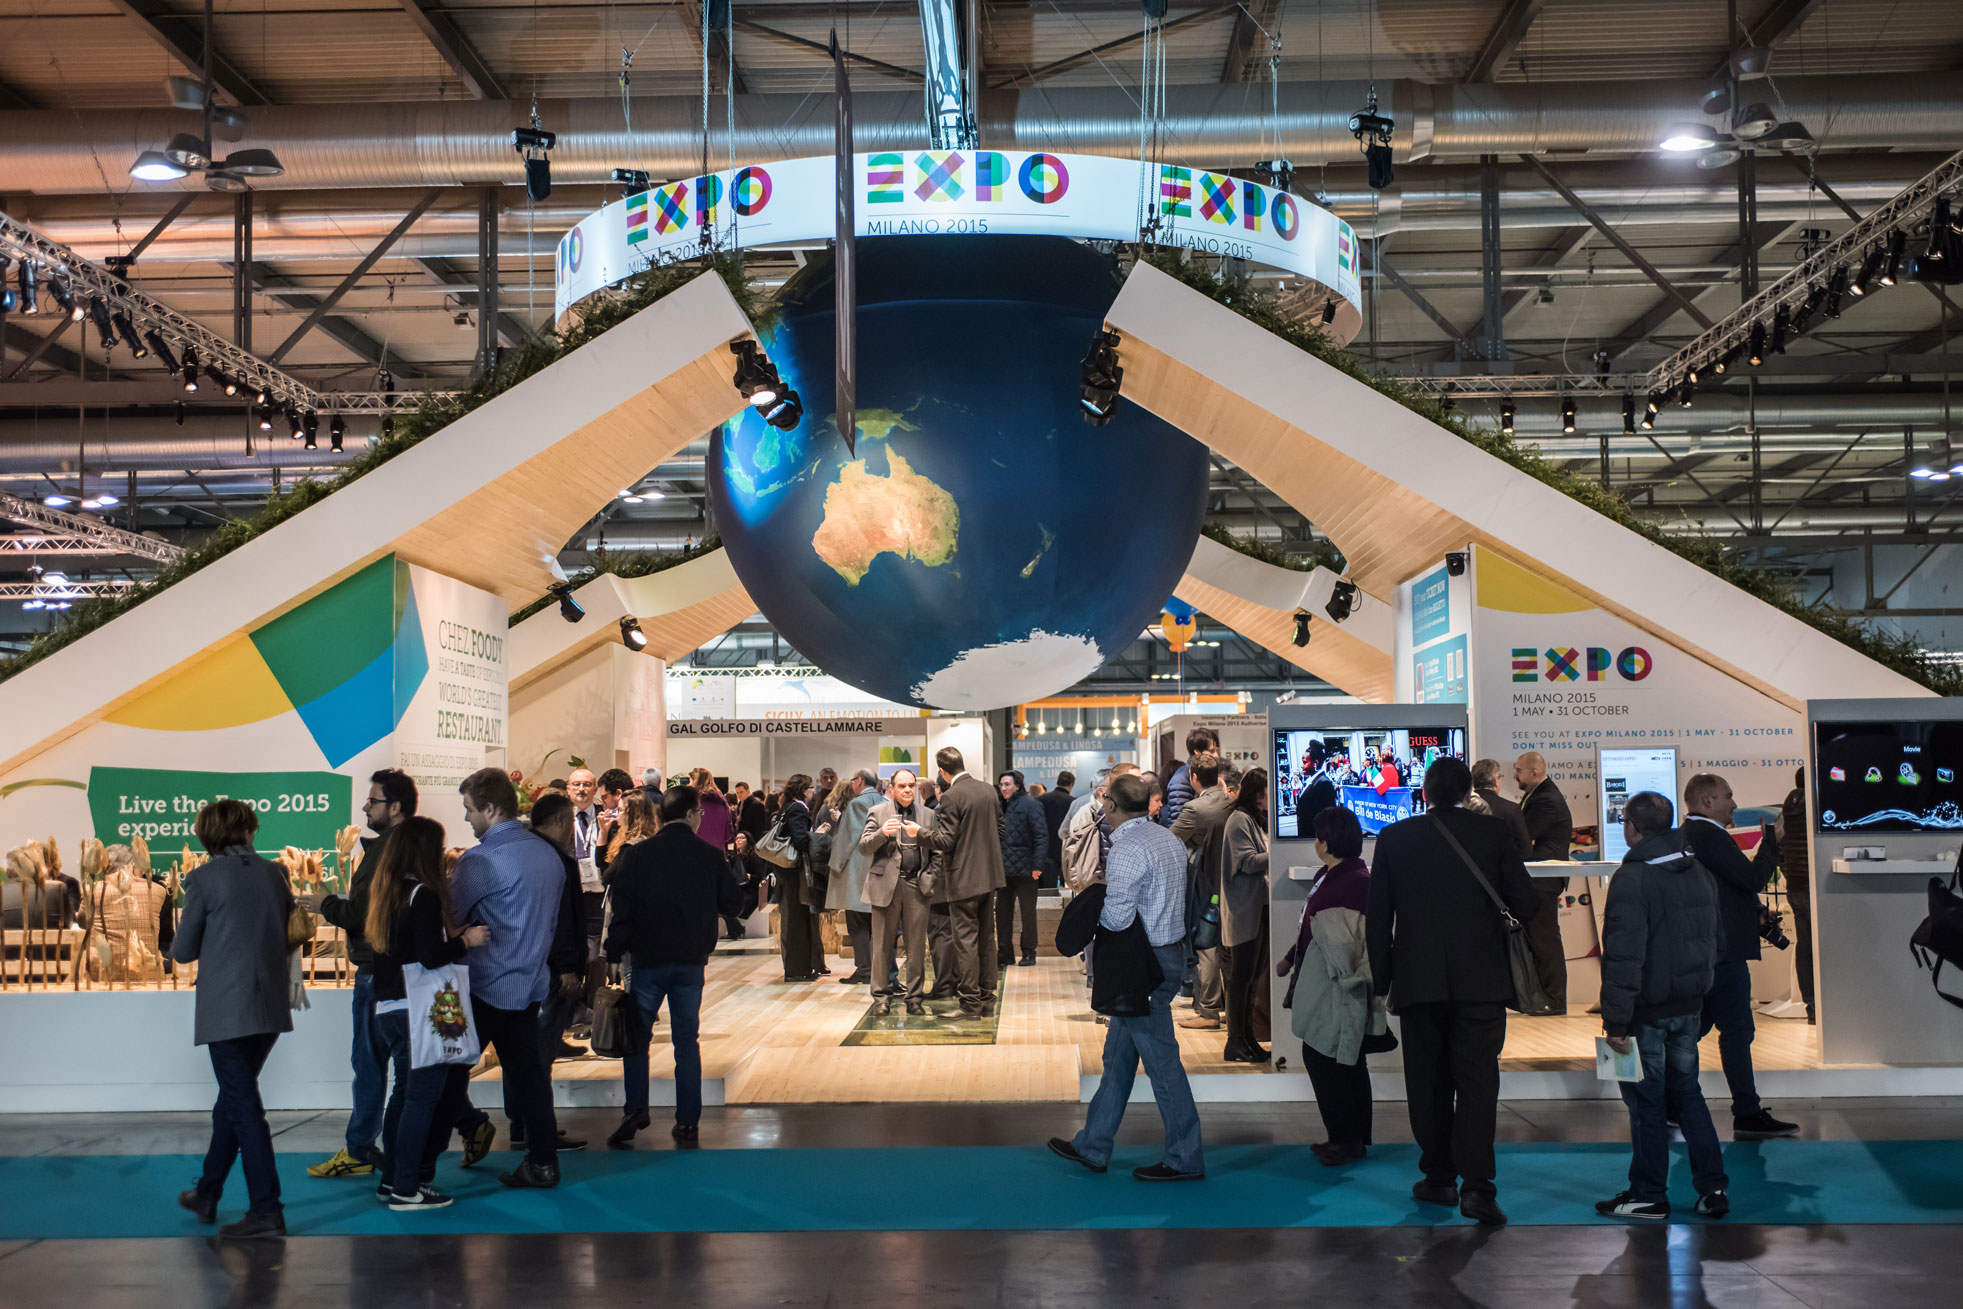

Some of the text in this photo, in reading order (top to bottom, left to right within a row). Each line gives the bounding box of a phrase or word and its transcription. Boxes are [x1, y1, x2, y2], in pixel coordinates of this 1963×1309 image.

[867, 151, 1069, 204] EXPO
[626, 165, 773, 246] EXPO
[1161, 164, 1300, 242] EXPO
[867, 219, 988, 235] MILANO 2015
[1162, 231, 1253, 260] MILANO 2015
[438, 619, 503, 665] CHEZ FOODY
[1512, 646, 1653, 682] EXPO
[1512, 692, 1596, 704] MILANO 2015
[1513, 707, 1518, 716] 1
[1522, 707, 1545, 716] MAY
[1557, 706, 1569, 716] 31
[1572, 705, 1629, 716] OCTOBER
[669, 722, 883, 734] GAL GOLFO DI CASTELLAMMARE
[1512, 731, 1529, 739] SEE
[1534, 731, 1555, 739] YOU
[1559, 730, 1570, 738] AT
[1575, 730, 1602, 738] EXPO
[1606, 729, 1647, 738] MILANO
[1650, 729, 1674, 737] 2015
[1695, 729, 1716, 737] MAY
[1729, 728, 1740, 736] 31
[1744, 728, 1794, 736] OCTOBER
[1013, 741, 1060, 751] AMPEDUSA
[1409, 736, 1438, 746] GUESS
[1512, 741, 1598, 750] DON'T MISS OUT
[1903, 745, 1921, 753] Movie
[1225, 751, 1260, 761] EXPO
[1013, 756, 1078, 769] LAMPEDUSA
[1578, 761, 1584, 769] A
[1706, 759, 1749, 767] MAGGIO
[1761, 759, 1772, 767] 31
[1776, 758, 1805, 767] OTTO
[1569, 772, 1597, 780] MANC
[119, 795, 167, 814] Live
[173, 795, 209, 813] the
[277, 793, 330, 812] 2015
[1355, 806, 1396, 823] Bill de Blasio
[118, 818, 197, 841] experie
